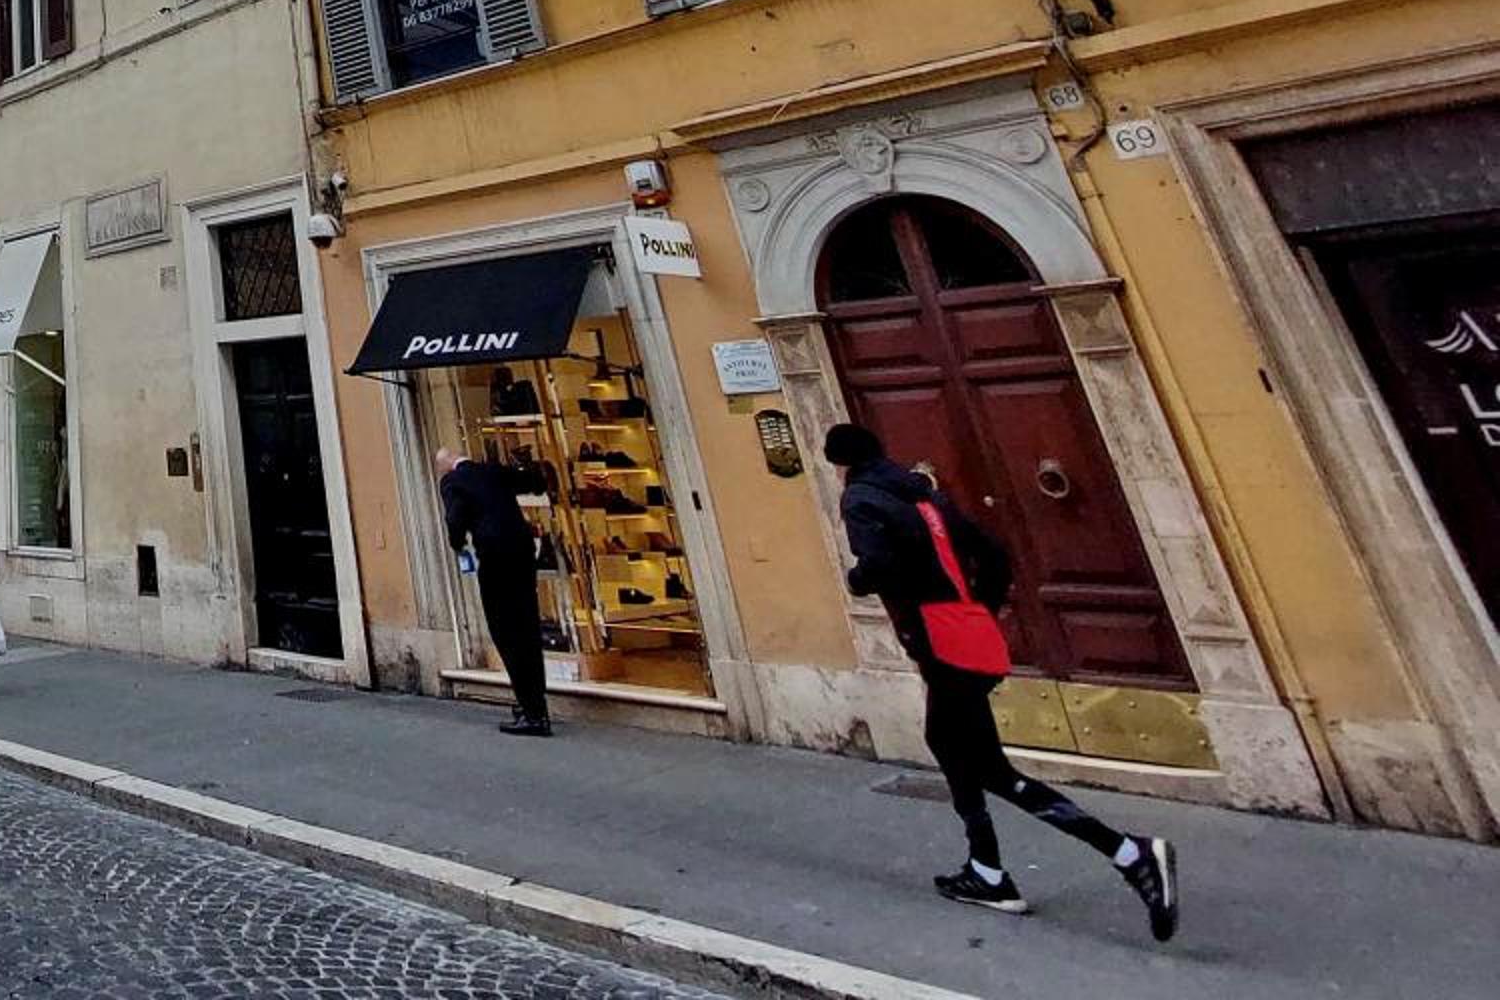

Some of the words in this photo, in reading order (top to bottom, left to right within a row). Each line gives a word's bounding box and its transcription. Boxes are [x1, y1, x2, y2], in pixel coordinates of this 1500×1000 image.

[1049, 85, 1080, 107] 68
[1115, 125, 1157, 152] 69
[402, 331, 519, 360] POLLINI
